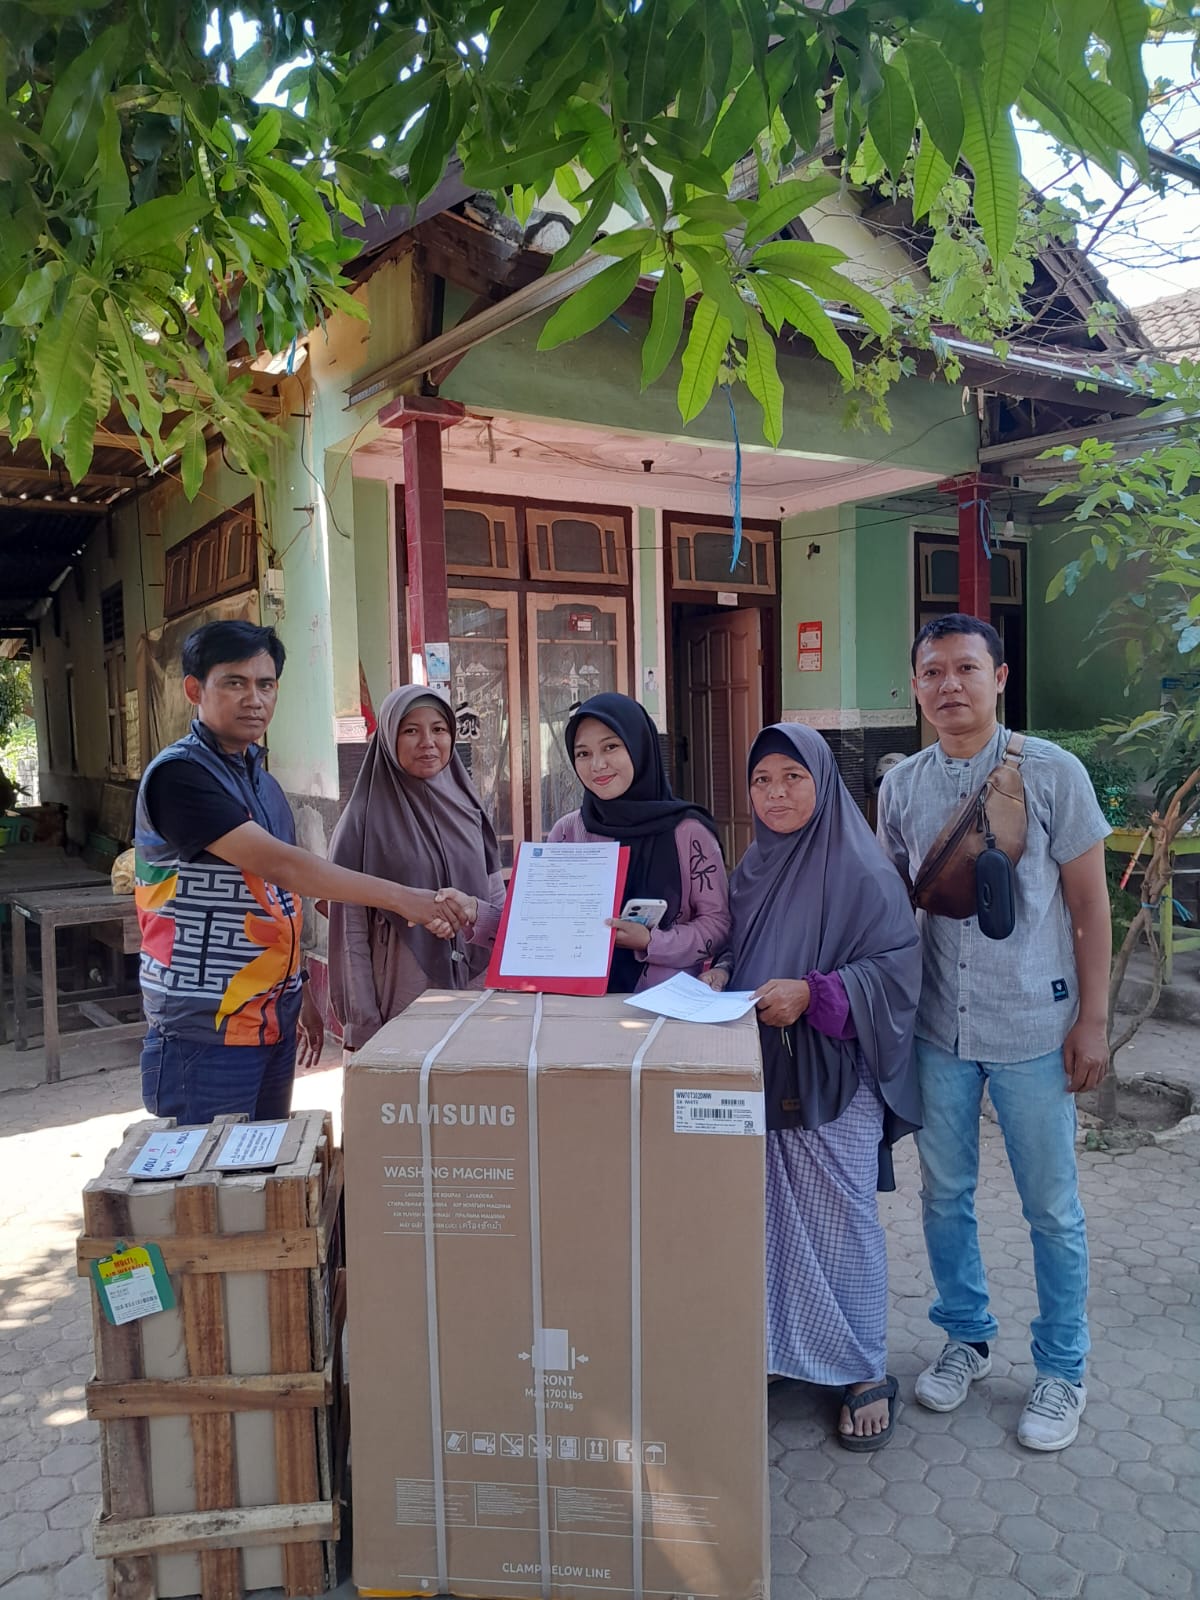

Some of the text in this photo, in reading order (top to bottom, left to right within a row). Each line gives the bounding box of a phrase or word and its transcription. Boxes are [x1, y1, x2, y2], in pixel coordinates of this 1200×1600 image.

[381, 1103, 516, 1126] SAMSUNG
[384, 1166, 515, 1180] WASHNG MACHINE
[536, 1375, 575, 1387] RONT
[502, 1562, 611, 1579] CLAMP ELOW LINE
